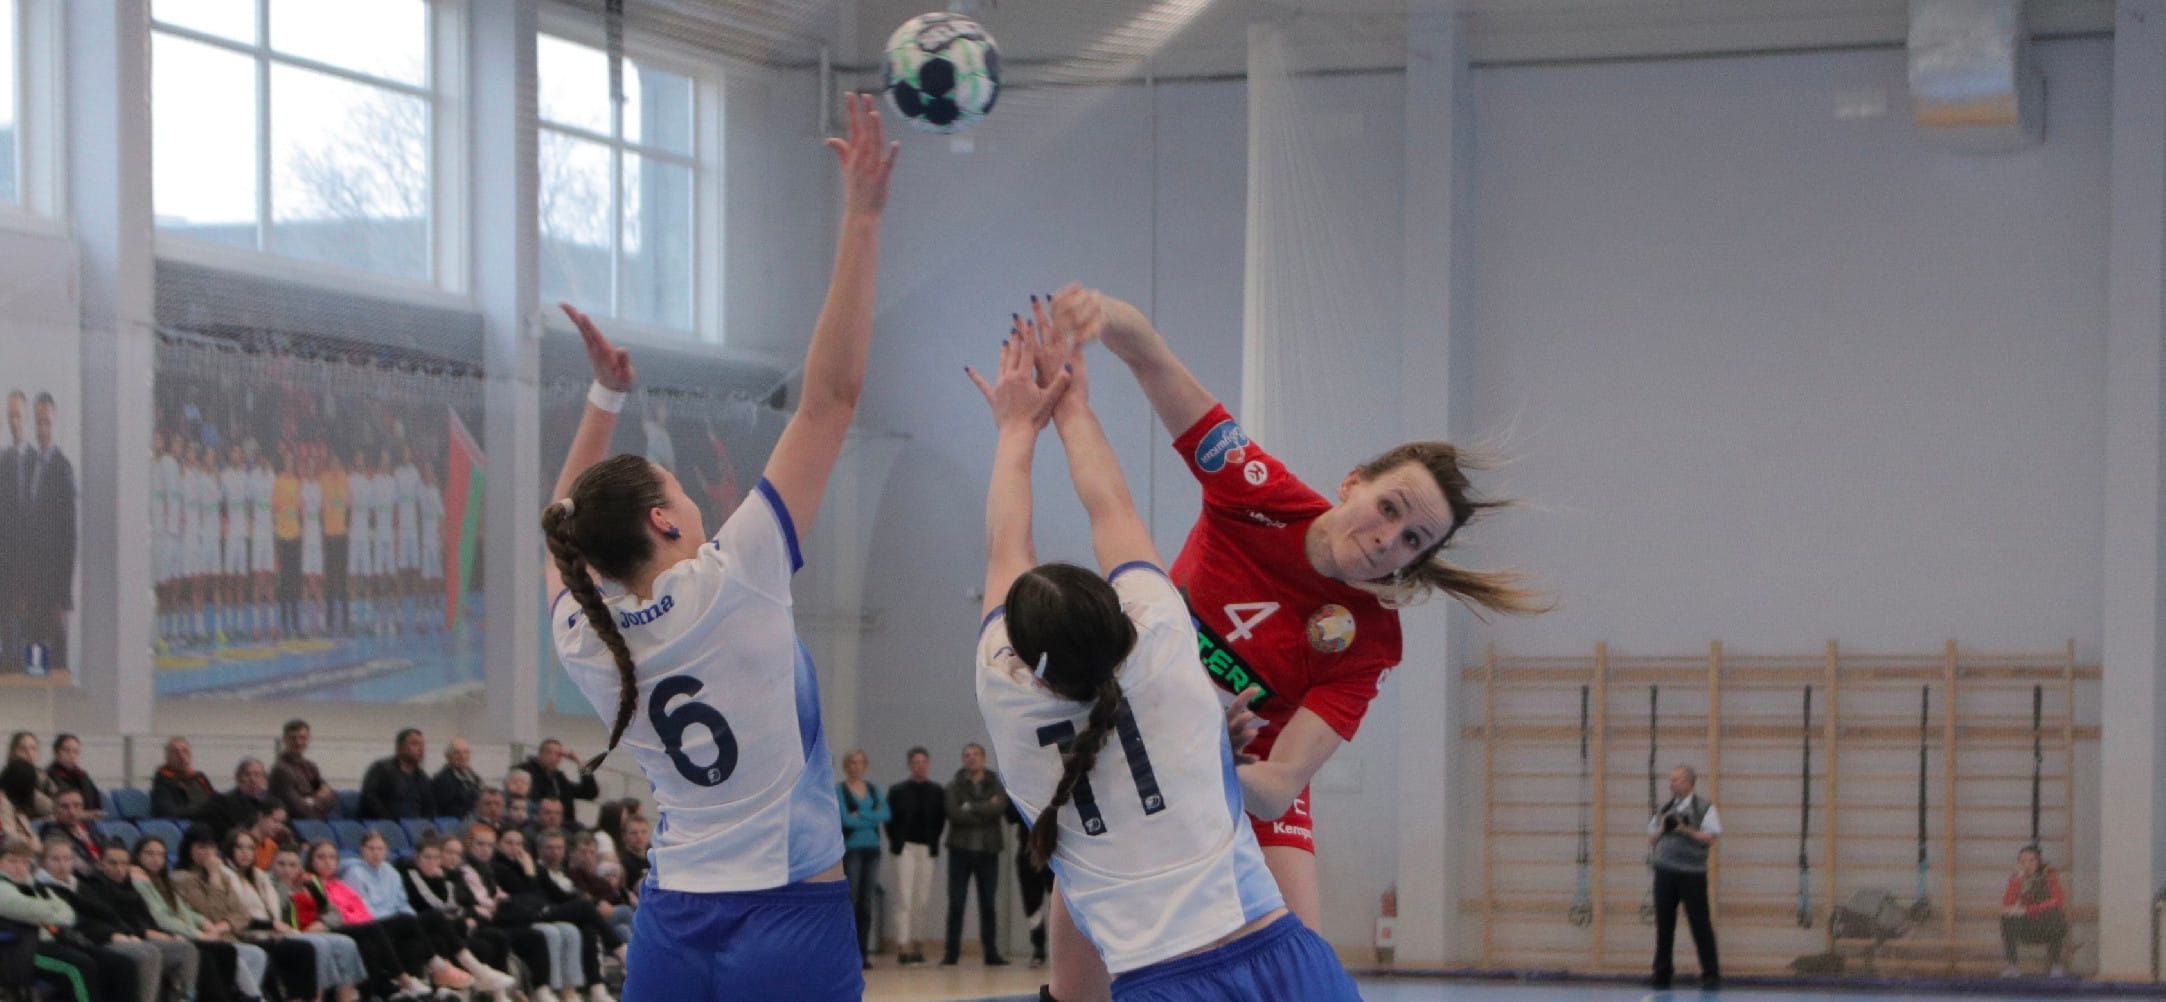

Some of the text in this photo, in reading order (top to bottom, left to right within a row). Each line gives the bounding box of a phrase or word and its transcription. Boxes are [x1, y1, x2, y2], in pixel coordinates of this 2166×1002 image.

[620, 595, 675, 628] Joma
[1223, 602, 1281, 643] 4
[648, 675, 738, 787] 6
[1036, 696, 1166, 835] 11
